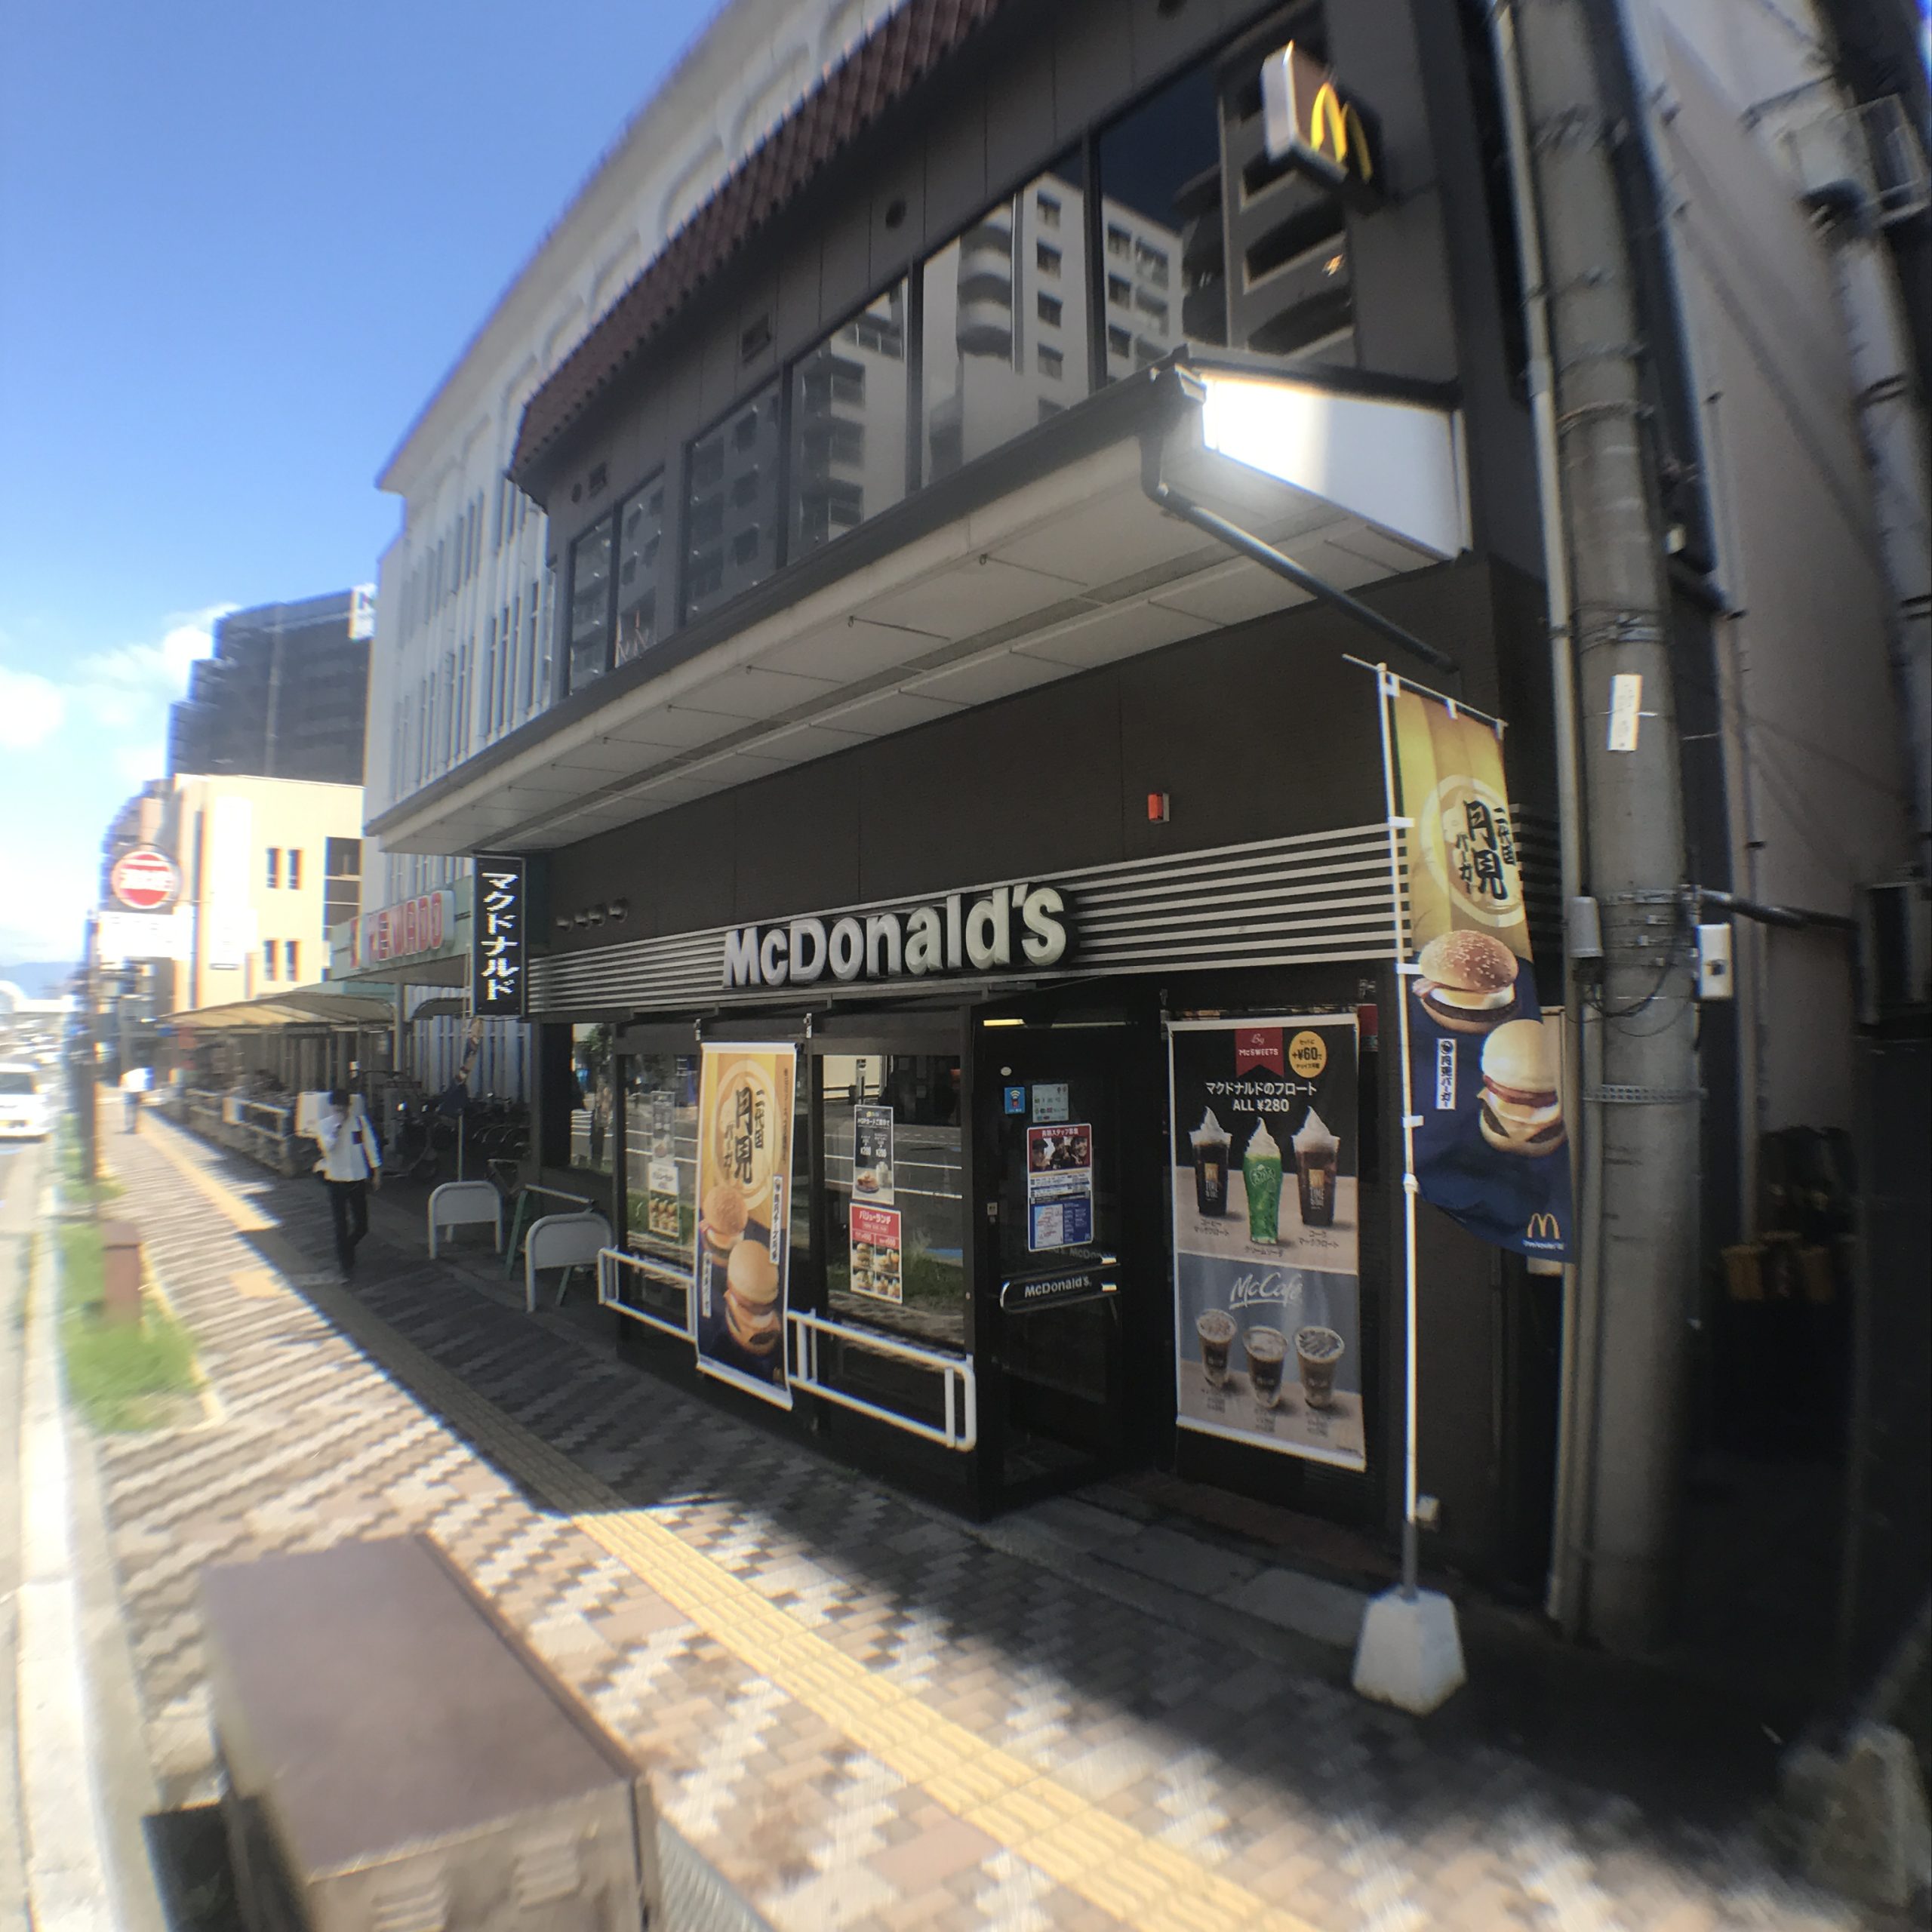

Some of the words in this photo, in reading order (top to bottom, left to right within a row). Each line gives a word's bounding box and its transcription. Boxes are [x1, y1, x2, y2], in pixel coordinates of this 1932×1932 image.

[1455, 833, 1473, 894] バーガー
[1463, 800, 1508, 900] 月見
[481, 872, 521, 1001] マクドナルド
[722, 883, 1066, 989] McDonald's
[1238, 1048, 1279, 1057] McSWEETS
[1205, 1081, 1318, 1096] マクドナルドのフロート
[1232, 1099, 1255, 1112] ALL
[1257, 1098, 1290, 1112] ¥280
[734, 1086, 753, 1184] 月見
[1024, 1275, 1090, 1298] McDonald's
